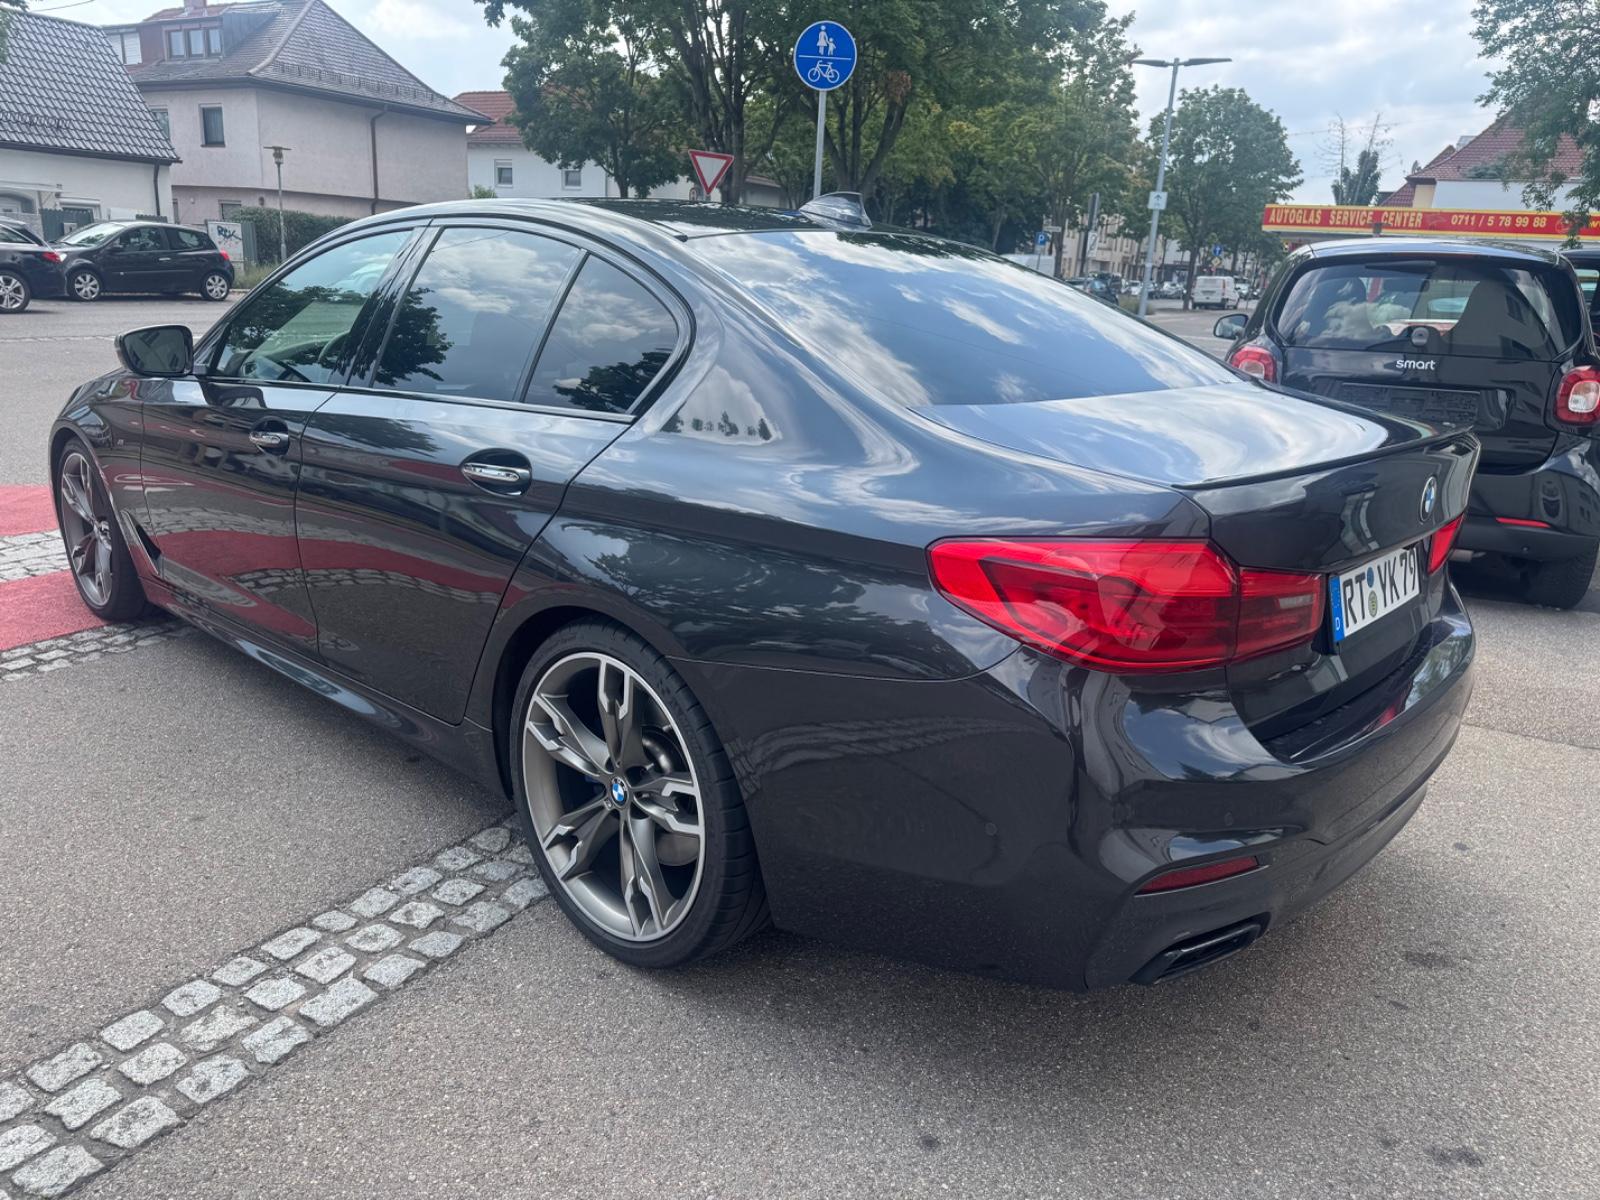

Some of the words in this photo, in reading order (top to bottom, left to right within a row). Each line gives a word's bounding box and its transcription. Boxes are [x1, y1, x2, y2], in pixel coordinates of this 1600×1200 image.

[1269, 208, 1322, 224] AUTOGLAS
[1329, 210, 1373, 225] SERVICE
[1381, 211, 1423, 227] CENTER
[1451, 214, 1475, 226] 0711
[1479, 215, 1484, 227] /
[1487, 215, 1495, 226] 5
[1498, 216, 1511, 227] 78
[1515, 216, 1529, 227] 99
[1533, 216, 1547, 228] 88
[1395, 359, 1436, 370] smart
[1335, 617, 1340, 631] D
[1343, 572, 1366, 629] RT
[1377, 557, 1400, 608] YK
[1400, 549, 1416, 595] 79
